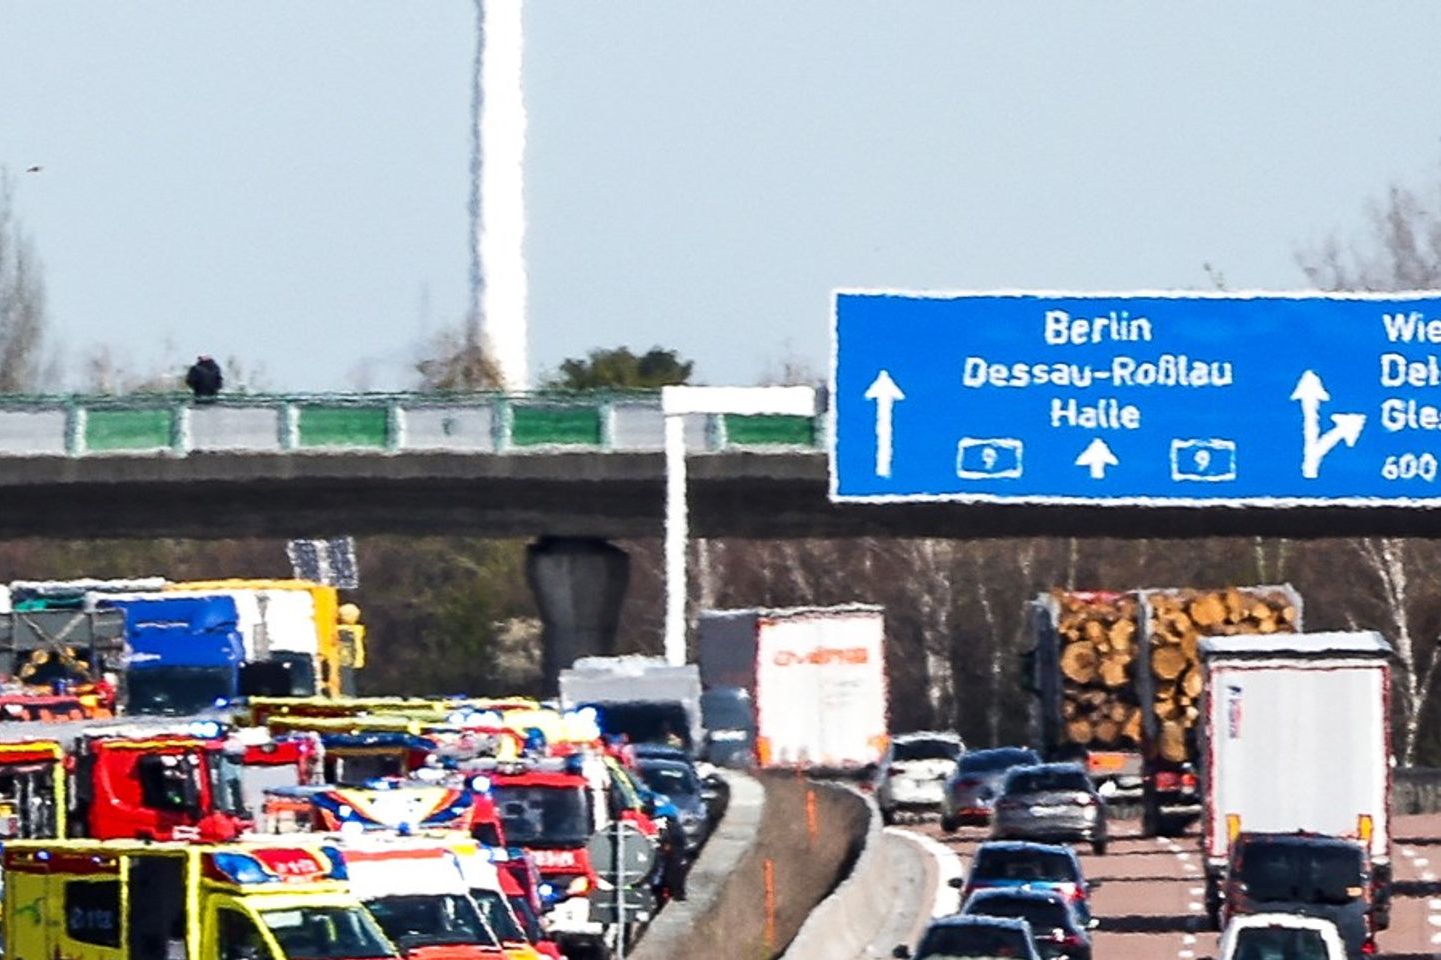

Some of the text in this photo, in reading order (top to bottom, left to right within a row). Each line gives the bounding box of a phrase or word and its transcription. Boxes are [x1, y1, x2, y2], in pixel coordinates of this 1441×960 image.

[1044, 310, 1152, 345] Berlin
[963, 355, 1232, 387] Dessau-Roßlau
[1050, 398, 1140, 430] Halle
[1380, 398, 1441, 432] Gle
[982, 447, 997, 469] 9
[1194, 449, 1210, 471] 9
[1381, 451, 1439, 483] 600
